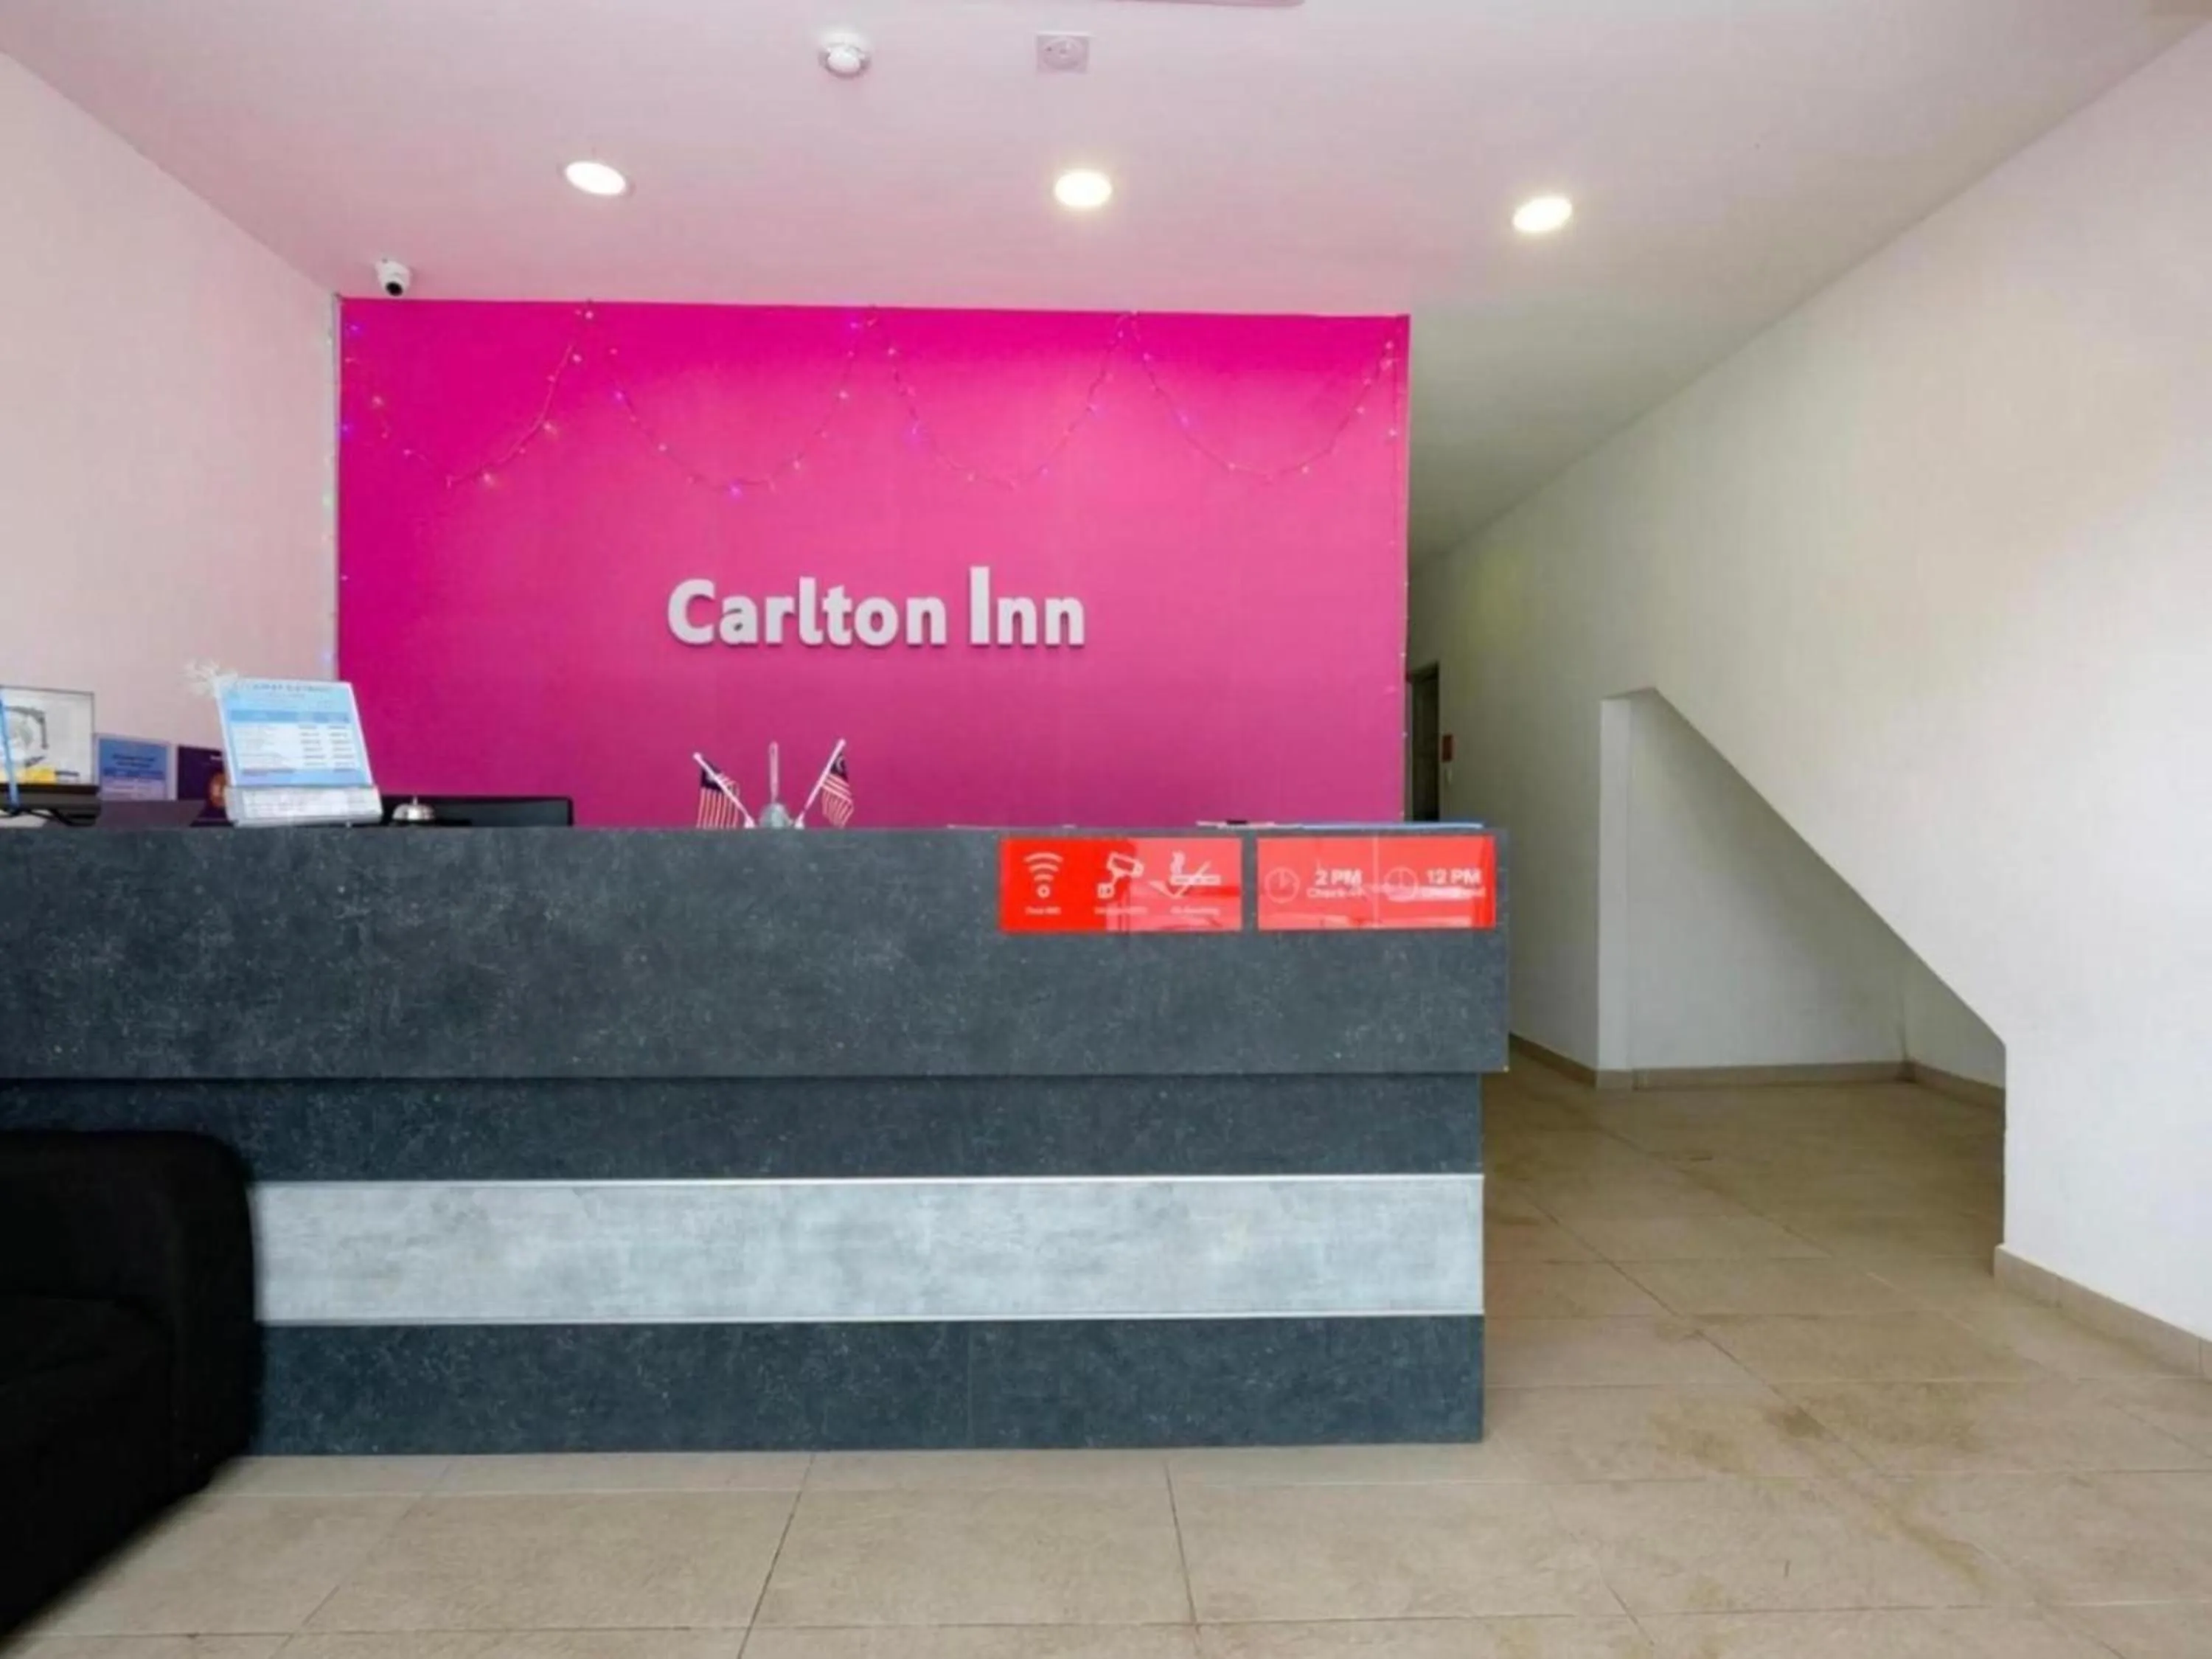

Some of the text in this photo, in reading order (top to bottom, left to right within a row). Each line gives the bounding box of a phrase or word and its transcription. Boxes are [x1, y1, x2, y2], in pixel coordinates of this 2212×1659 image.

[667, 565, 1086, 647] Carlton Inn
[1314, 868, 1363, 886] 2 PM
[1425, 868, 1481, 886] 12 PM
